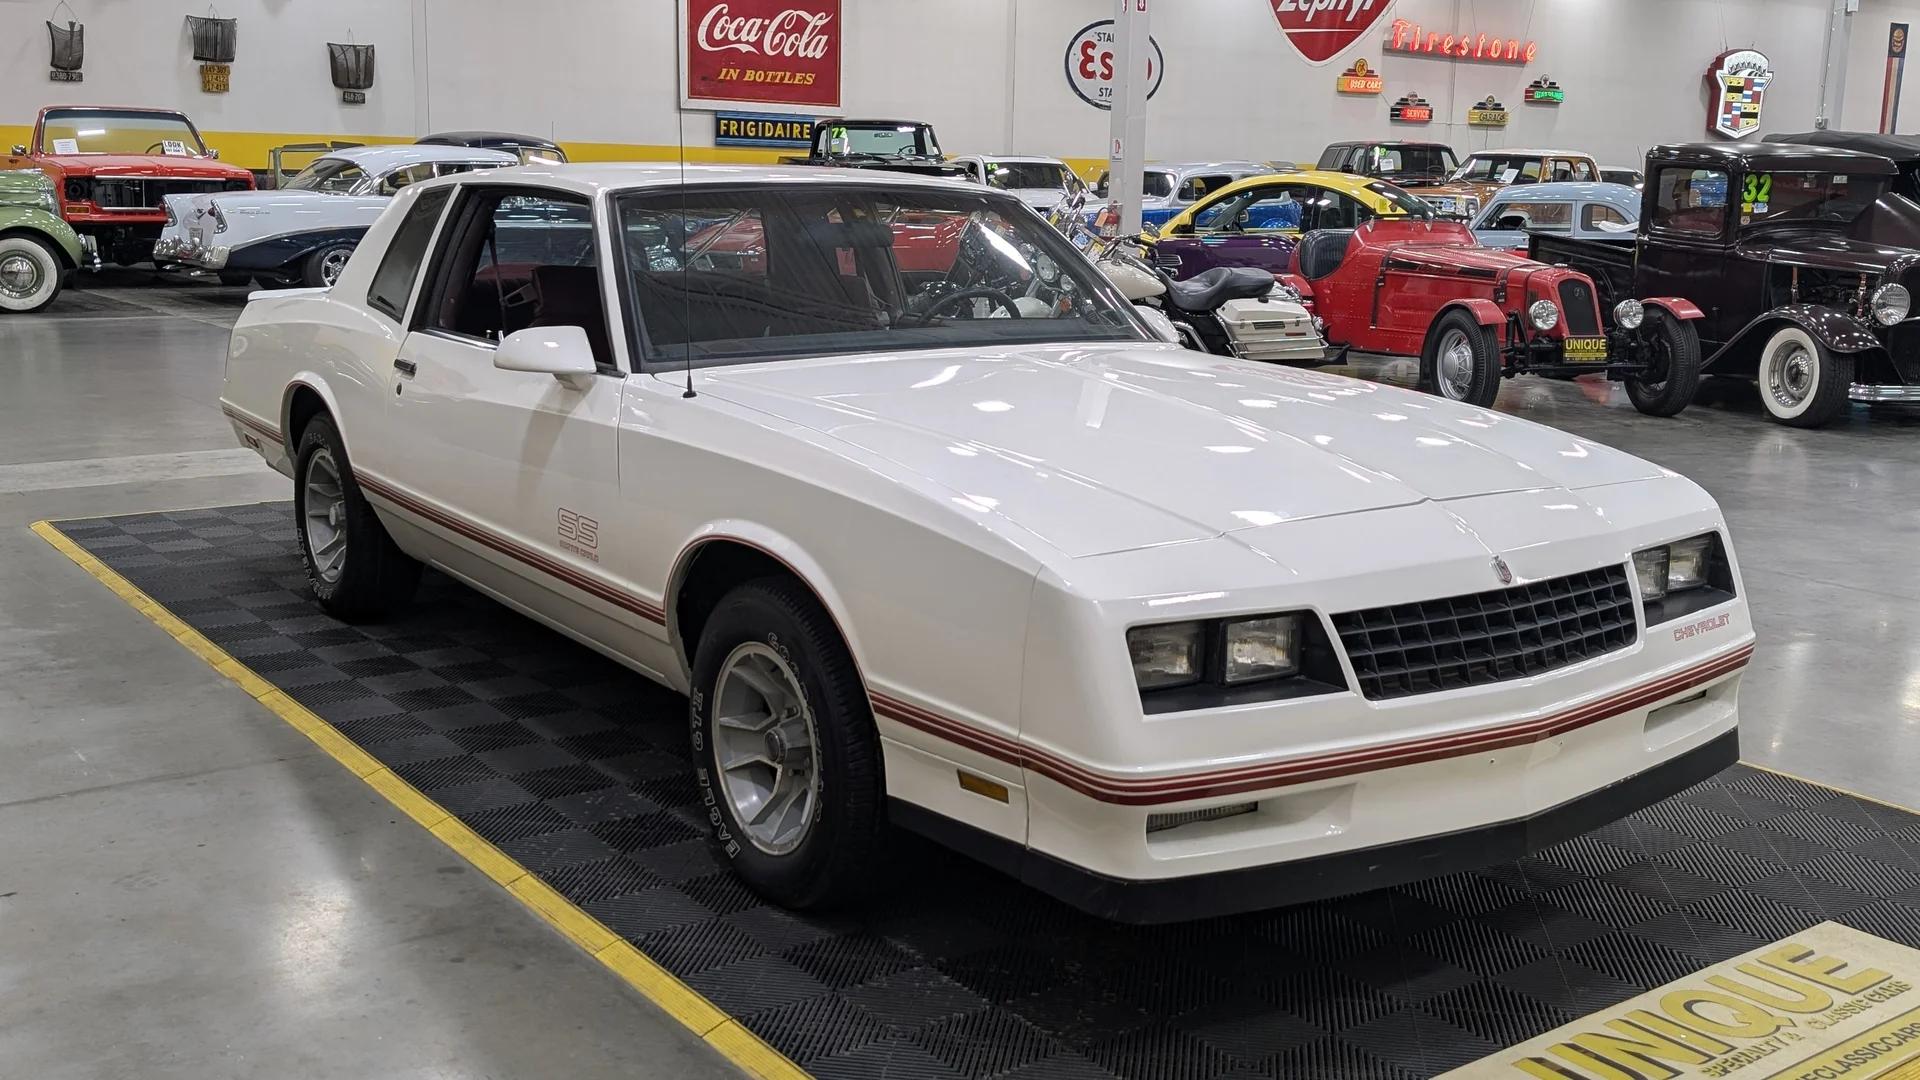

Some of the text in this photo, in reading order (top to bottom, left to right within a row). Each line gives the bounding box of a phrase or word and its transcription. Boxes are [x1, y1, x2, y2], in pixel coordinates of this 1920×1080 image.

[697, 3, 834, 59] Coca-Cola
[1393, 18, 1537, 62] Firestone
[718, 68, 816, 85] IN BOTTLES
[1366, 81, 1383, 89] CARS
[1534, 90, 1565, 100] GASOLINE
[1406, 110, 1430, 119] SERVICE
[720, 120, 811, 139] FRIGIDAIRE
[1743, 174, 1772, 202] 32
[1565, 339, 1607, 350] UNIQUE
[558, 507, 599, 549] SS
[1673, 612, 1731, 641] CHEVROLET
[697, 767, 741, 859] EAGLE
[1511, 942, 1894, 1080] UNIQUE
[1805, 998, 1873, 1031] CLASSIC
